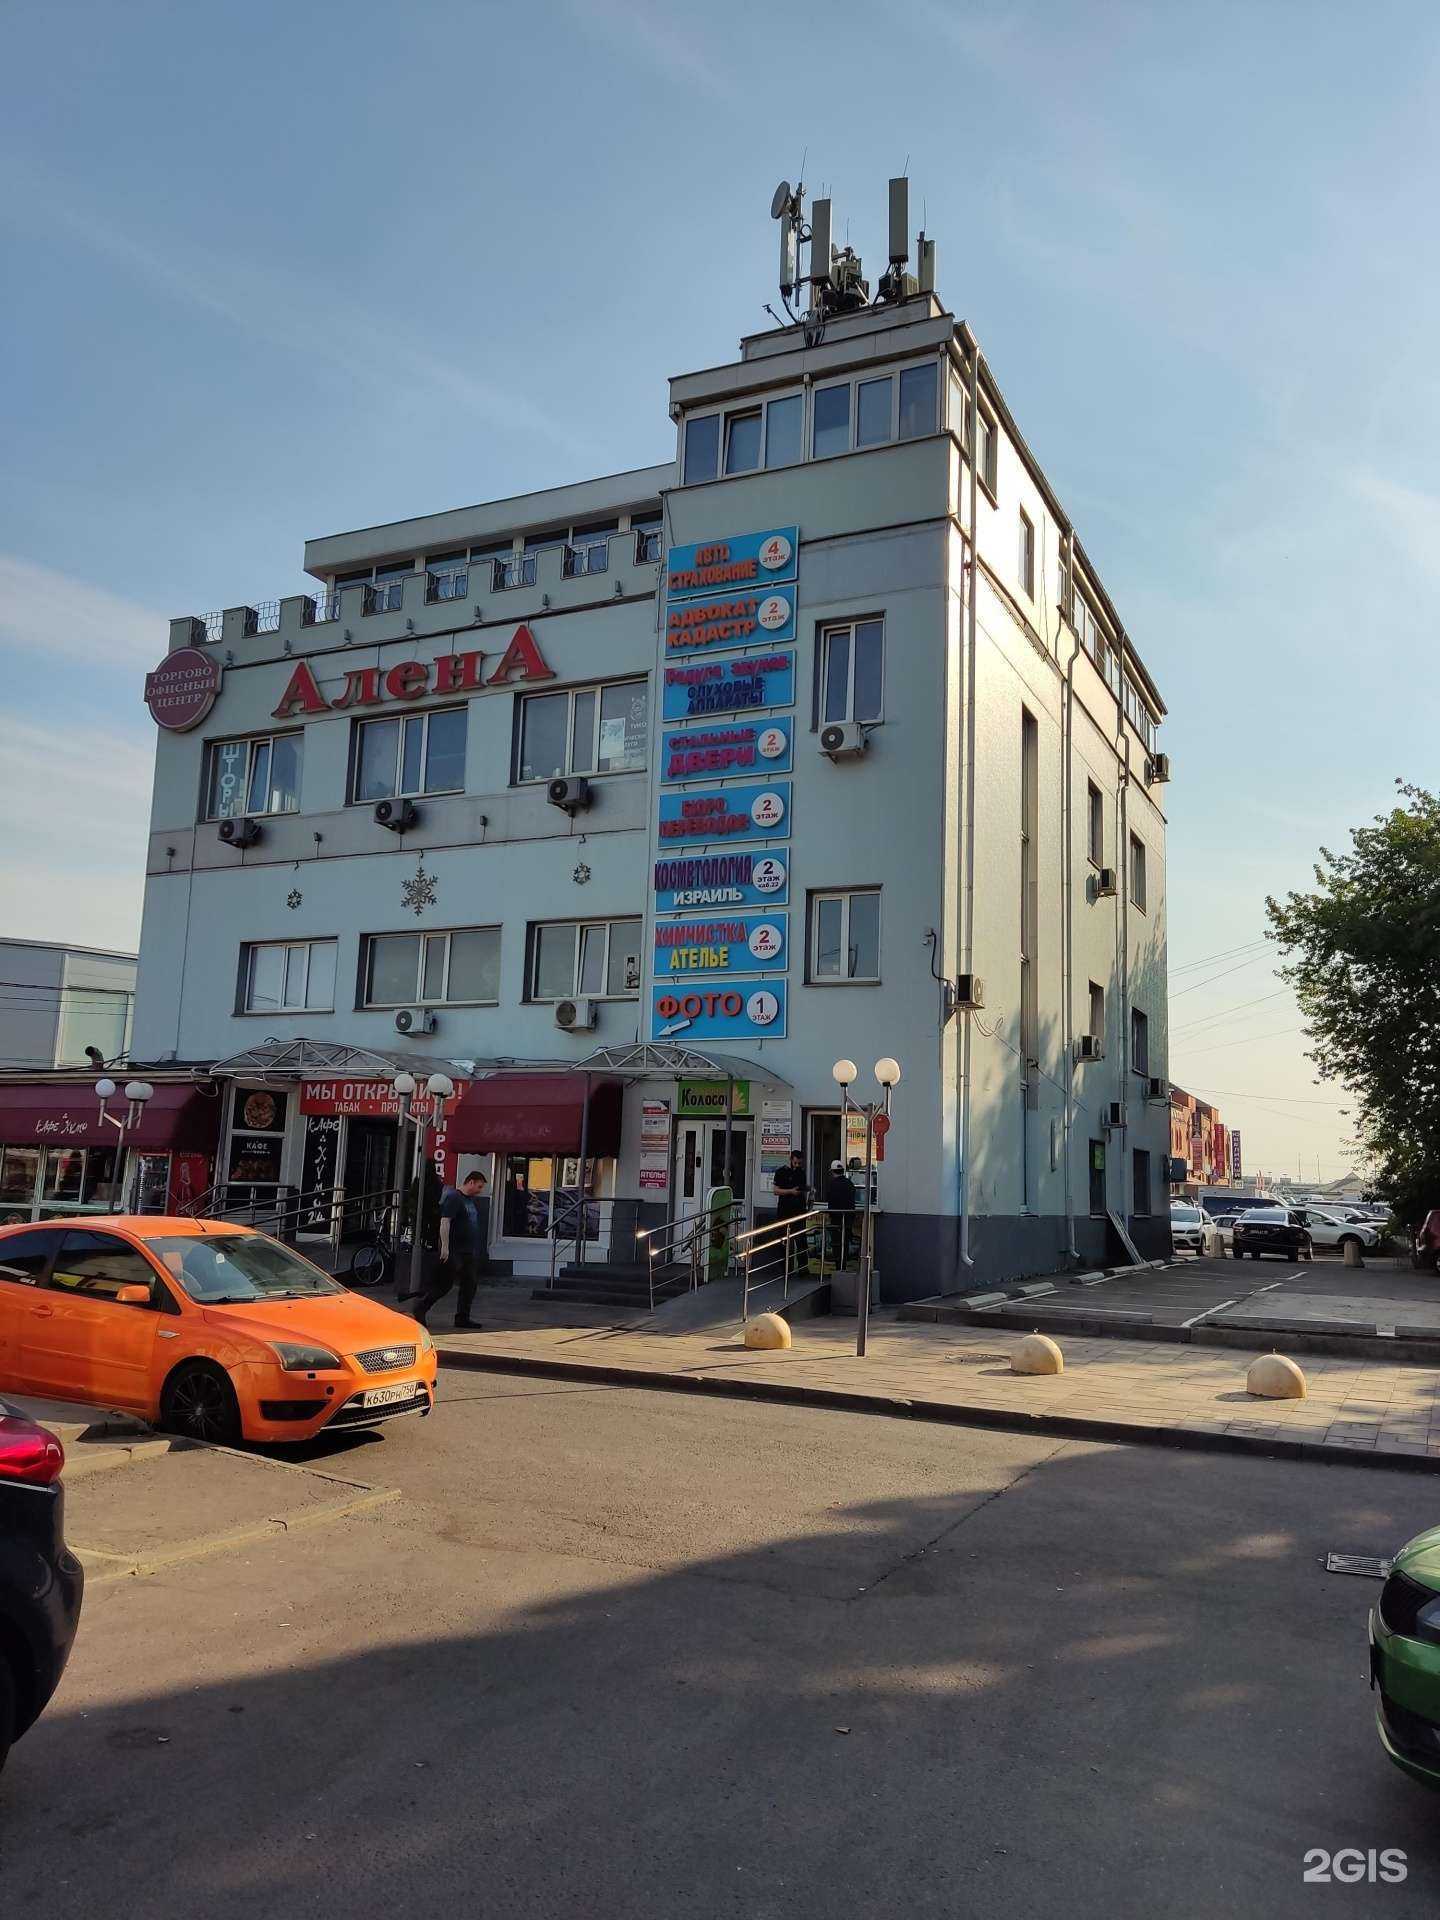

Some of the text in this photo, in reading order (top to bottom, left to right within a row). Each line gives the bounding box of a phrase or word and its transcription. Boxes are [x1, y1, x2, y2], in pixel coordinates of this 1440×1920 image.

[695, 543, 730, 567] АВТО
[767, 541, 780, 554] 4
[762, 554, 787, 563] этаж
[669, 560, 758, 590] СТРАХОВАНИЕ
[669, 599, 758, 628] АДВОКАТ
[768, 602, 779, 614] 2
[761, 614, 786, 623] этаж
[668, 618, 756, 648] КАДАСТР
[152, 666, 213, 683] ТОРГОВО
[146, 678, 215, 697] ОФИСНЫЙ
[687, 676, 766, 698] СЛУХОВЫЕ
[157, 693, 202, 708] ЦЕНТР
[687, 689, 765, 714] АППАРАТЫ
[767, 734, 777, 747] 2
[668, 745, 756, 777] ДВЕРИ
[219, 743, 241, 819] ШТОРЫ
[682, 797, 727, 818] БЮРО
[763, 800, 772, 811] 2
[659, 813, 751, 838] ПЕРЕВОДОВ
[755, 812, 779, 821] этаж
[654, 856, 753, 890] КОСМЕТОЛОГИЯ
[764, 861, 774, 874] 2
[757, 874, 780, 882] этаж
[673, 888, 744, 906] ИЗРАИЛЬ
[655, 922, 748, 947] ХИМЧИСТКА
[759, 930, 770, 944] 2
[670, 945, 729, 969] АТЕЛЬЕ
[753, 944, 777, 952] этаж
[656, 991, 743, 1019] ФОТО
[757, 996, 764, 1014] 1
[752, 1013, 772, 1021] ЭТАЖ
[306, 1082, 464, 1101] МЫ ОТКРЫИ!
[334, 1101, 429, 1113] ТАБАК ПРОКТЫ
